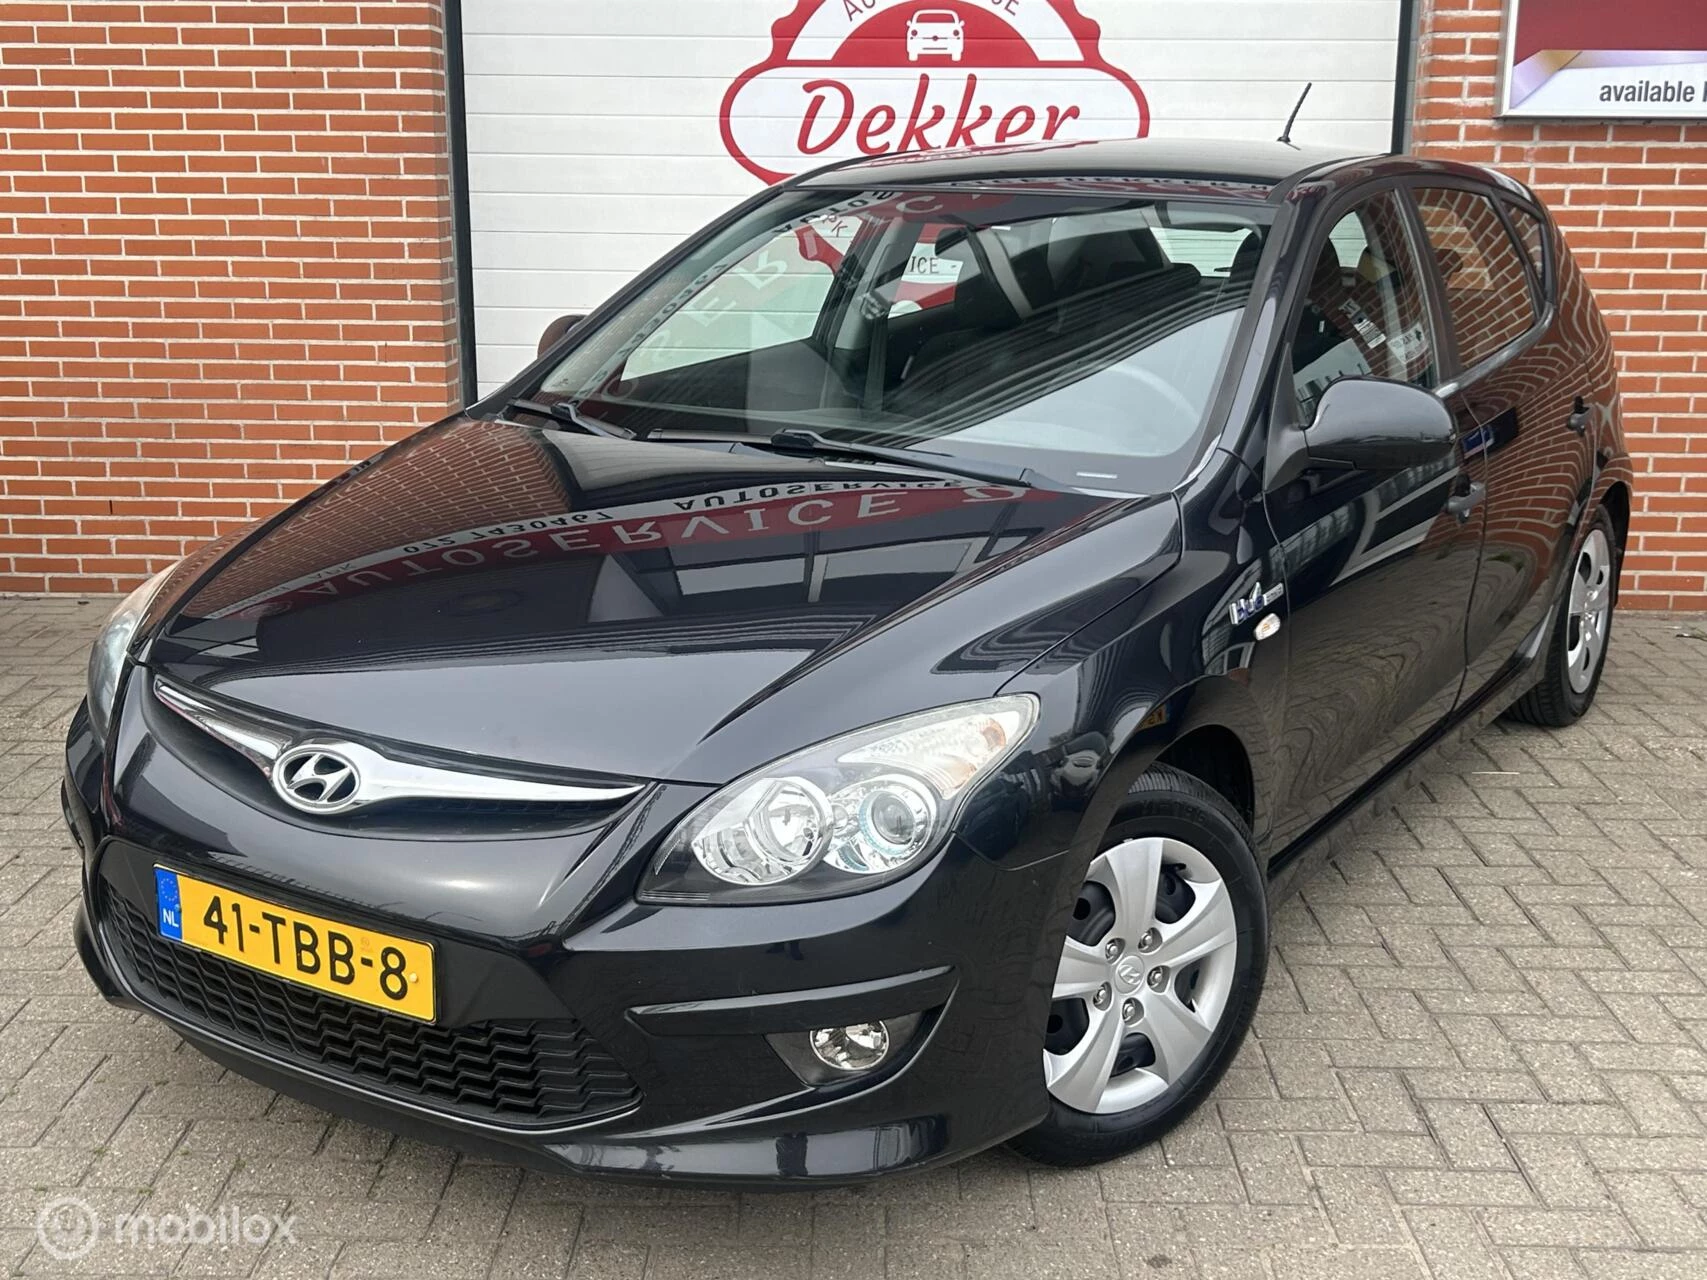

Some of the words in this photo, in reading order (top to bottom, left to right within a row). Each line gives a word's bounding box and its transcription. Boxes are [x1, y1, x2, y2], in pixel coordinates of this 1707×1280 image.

[796, 73, 1081, 155] Dekker
[1599, 80, 1695, 103] available
[163, 907, 179, 929] NL
[203, 895, 409, 1001] 41-TBB-8
